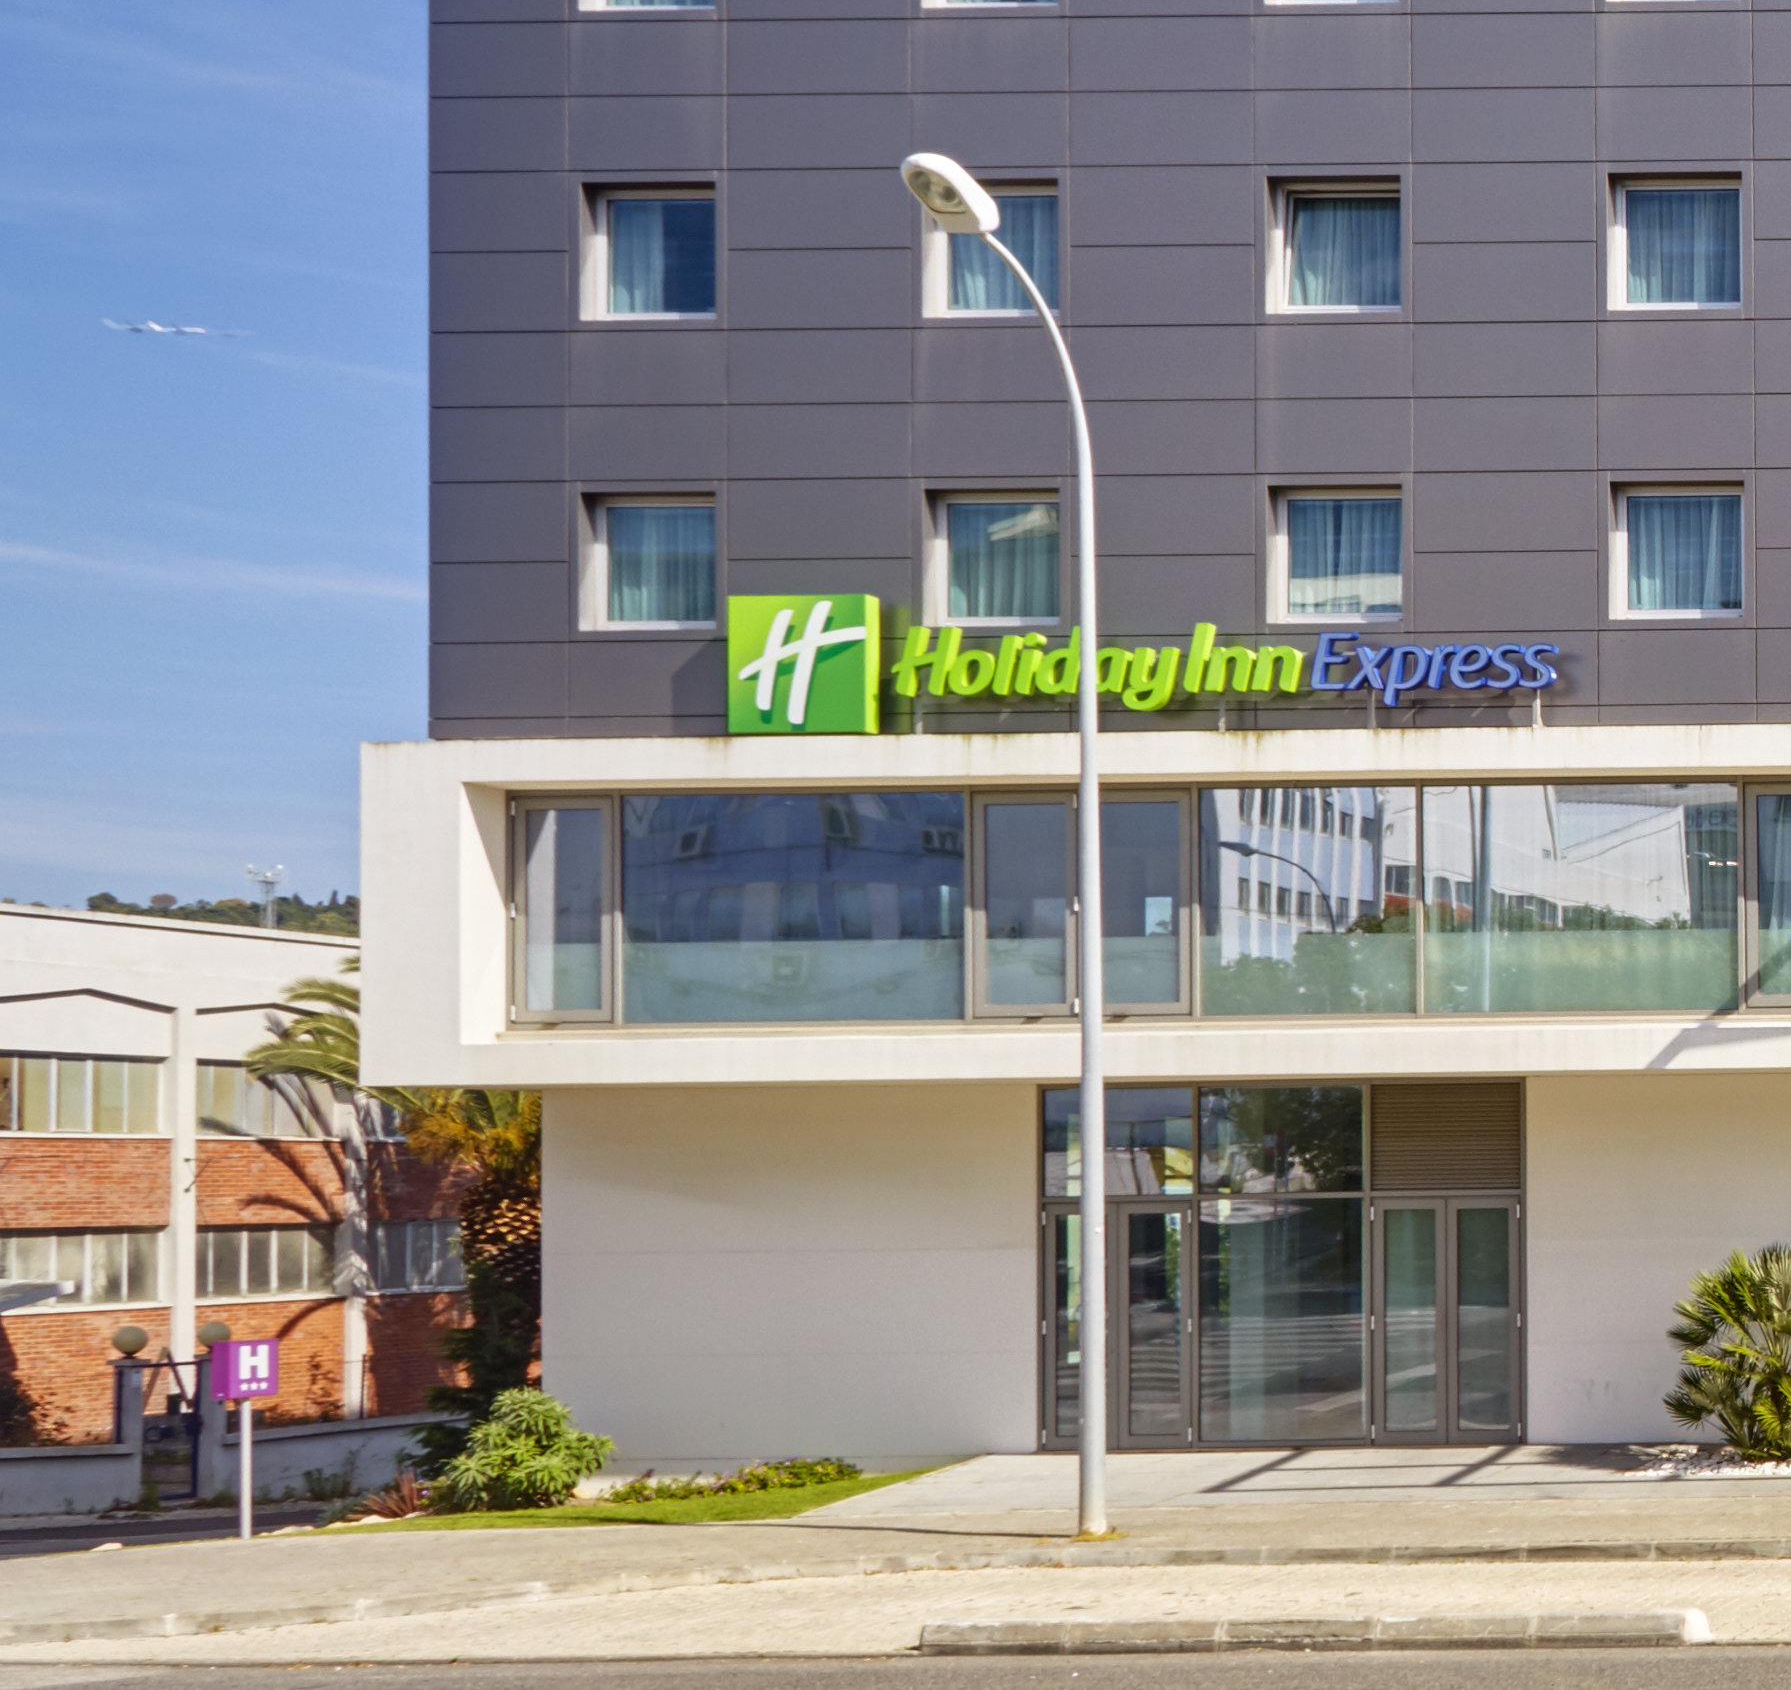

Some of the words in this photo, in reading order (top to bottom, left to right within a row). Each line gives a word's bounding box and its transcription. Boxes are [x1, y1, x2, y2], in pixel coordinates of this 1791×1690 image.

[891, 625, 1181, 711] Holiday
[1183, 622, 1304, 694] Inn
[1310, 631, 1560, 707] Express
[238, 1344, 270, 1380] H
